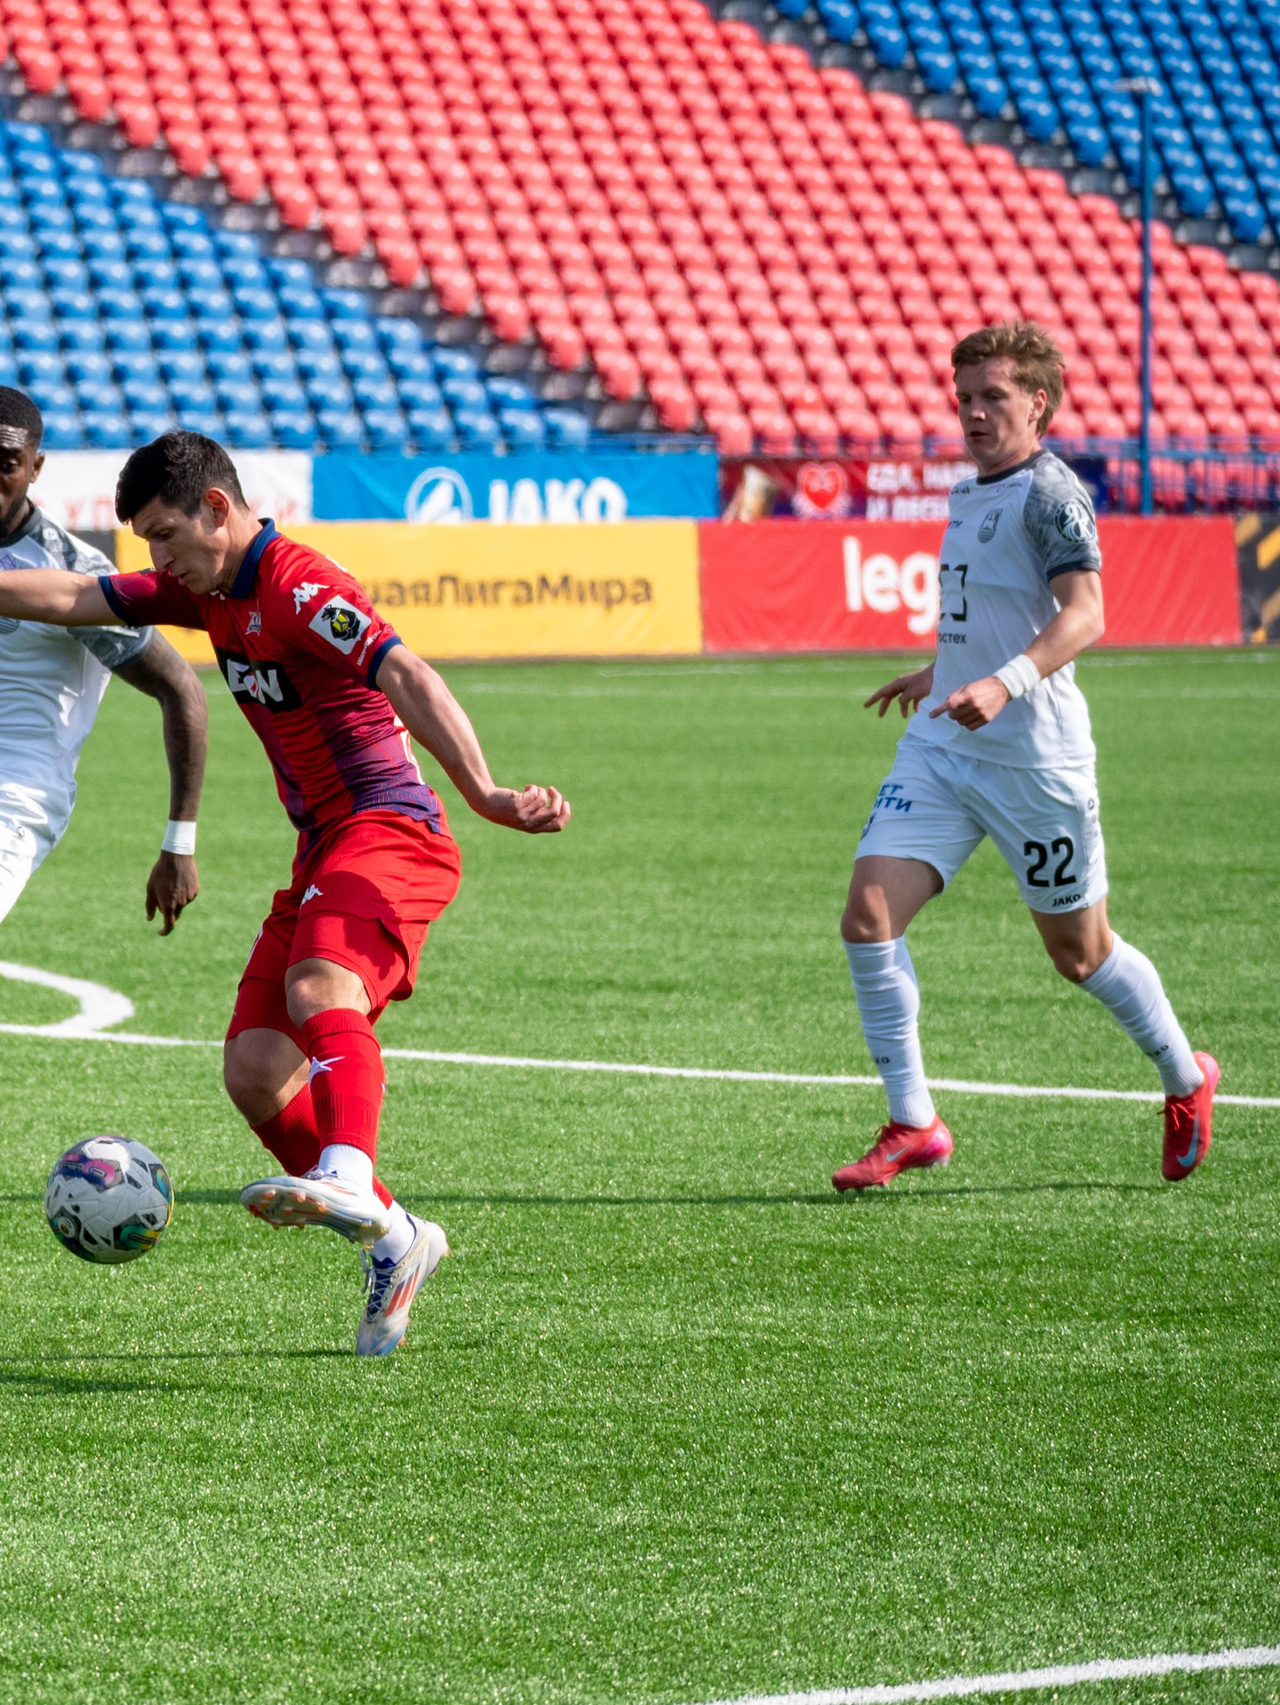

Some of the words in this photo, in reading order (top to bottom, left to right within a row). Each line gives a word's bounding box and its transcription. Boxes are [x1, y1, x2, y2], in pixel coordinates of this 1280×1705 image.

[937, 631, 967, 645] остех
[878, 784, 904, 797] ЕТ
[1023, 836, 1077, 888] 22
[1051, 893, 1081, 908] JAKO
